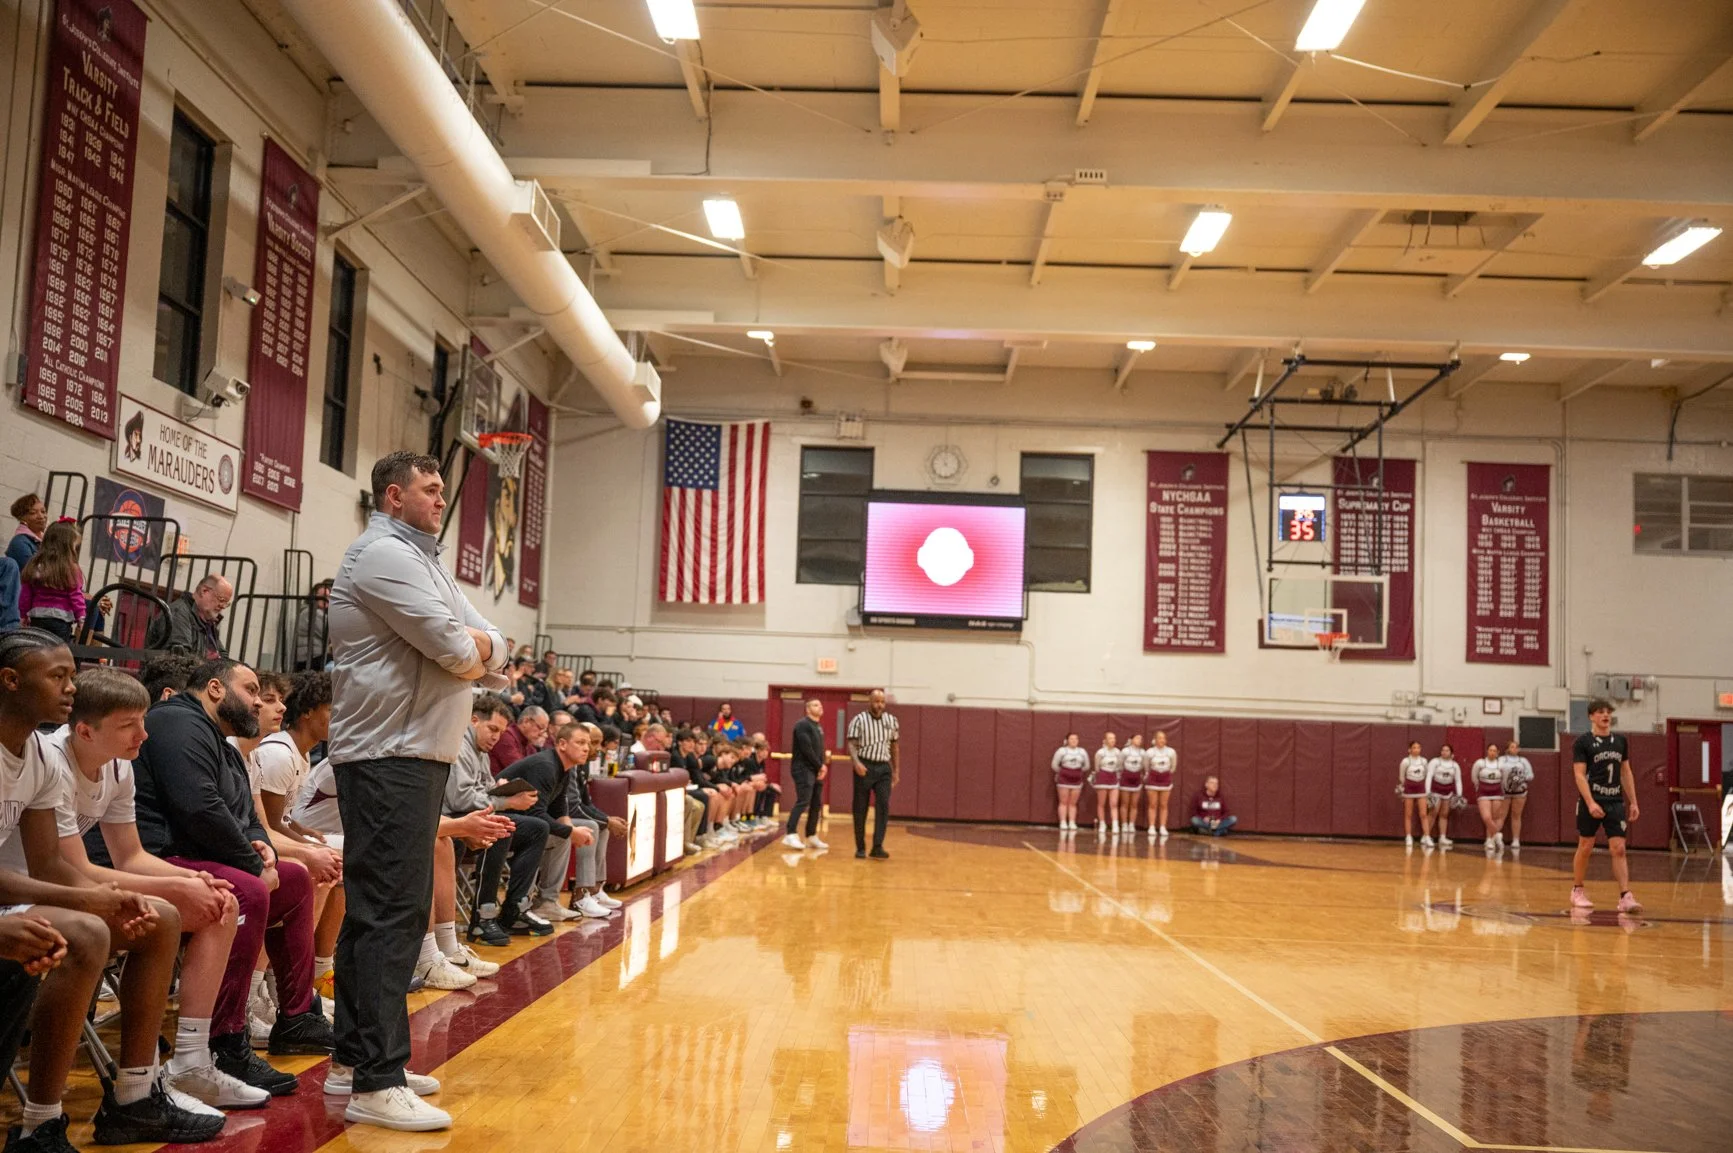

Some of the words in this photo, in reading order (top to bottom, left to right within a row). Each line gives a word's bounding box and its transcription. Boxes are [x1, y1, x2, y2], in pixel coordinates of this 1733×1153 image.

[82, 50, 119, 100] VARSITY
[63, 65, 94, 111] TRACK
[95, 93, 103, 116] &
[104, 100, 129, 139] FIELD
[58, 143, 75, 165] 1947
[66, 378, 83, 397] 1972
[37, 398, 56, 416] 2017
[65, 410, 85, 428] 2024
[38, 382, 57, 401] 1985
[65, 395, 84, 414] 2005
[91, 406, 109, 424] 2013
[159, 423, 181, 449] HOME
[182, 431, 193, 451] OF
[194, 439, 208, 460] THE
[147, 443, 215, 495] MARAUDERS
[1162, 490, 1212, 503] NYCHSAA
[1391, 499, 1411, 513] CUP
[1149, 501, 1175, 514] STATE
[1177, 503, 1225, 517] CHAMPIONS
[1491, 501, 1526, 515] VARSITY
[1289, 519, 1315, 541] 35
[1481, 514, 1536, 529] BASKETBALL
[1606, 762, 1614, 784] 1
[1592, 782, 1621, 796] PARK
